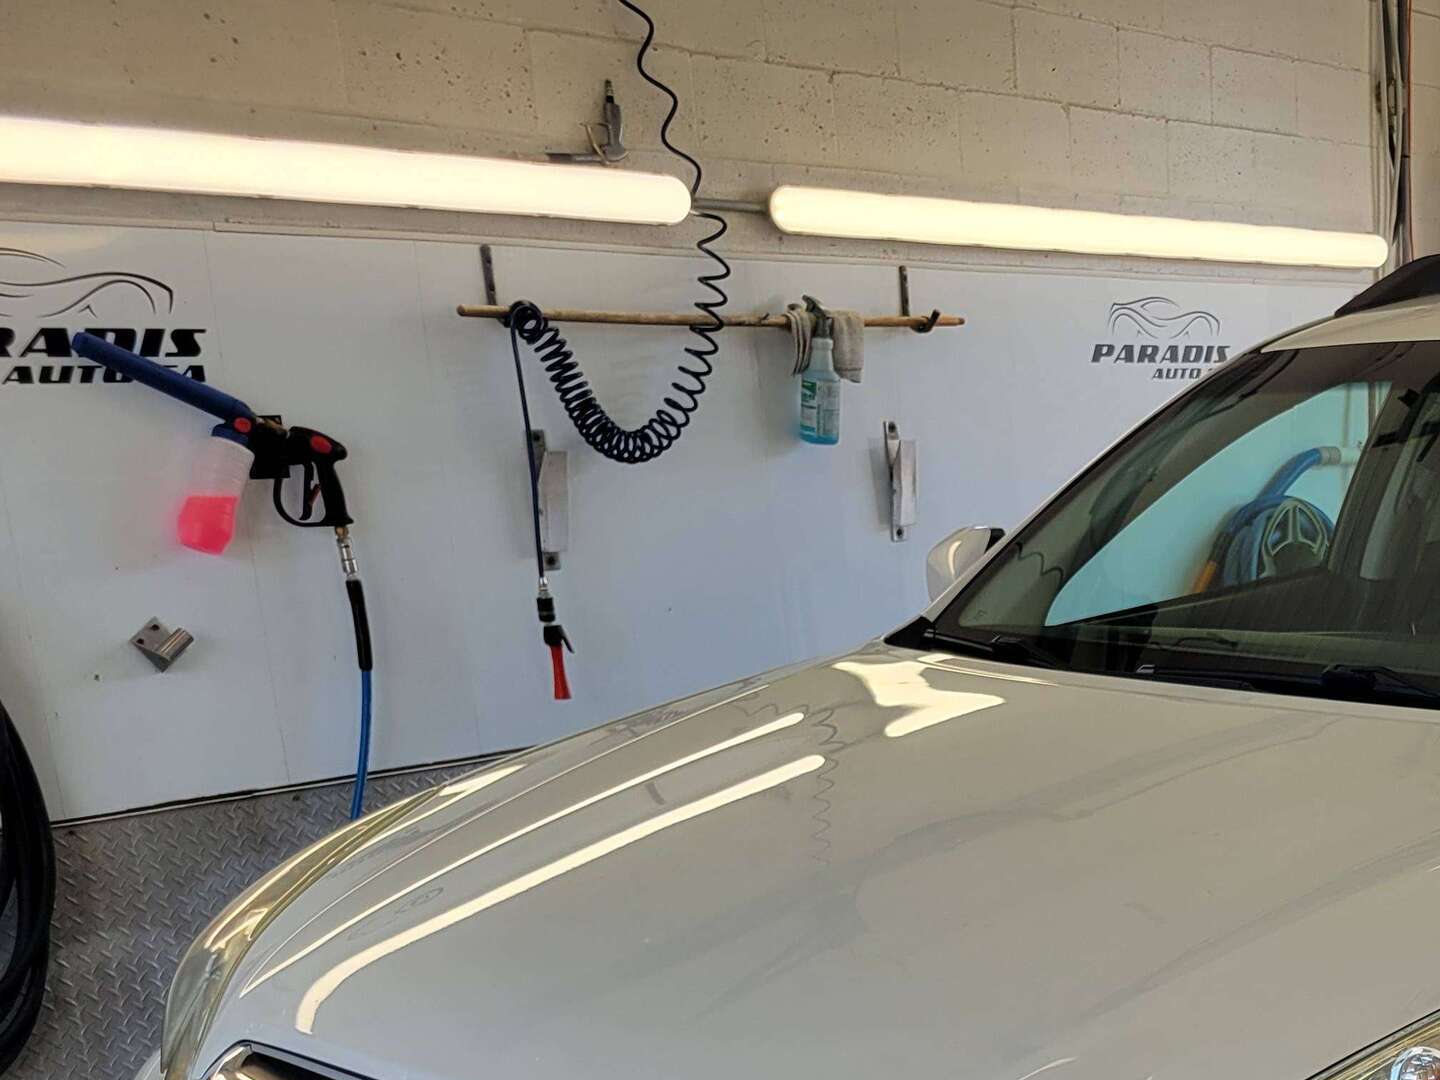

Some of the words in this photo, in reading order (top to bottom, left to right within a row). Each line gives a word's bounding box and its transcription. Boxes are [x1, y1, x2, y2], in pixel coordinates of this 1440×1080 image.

[0, 328, 207, 357] ADIS
[1091, 344, 1230, 363] PARADIS
[1152, 368, 1201, 379] AUTO
